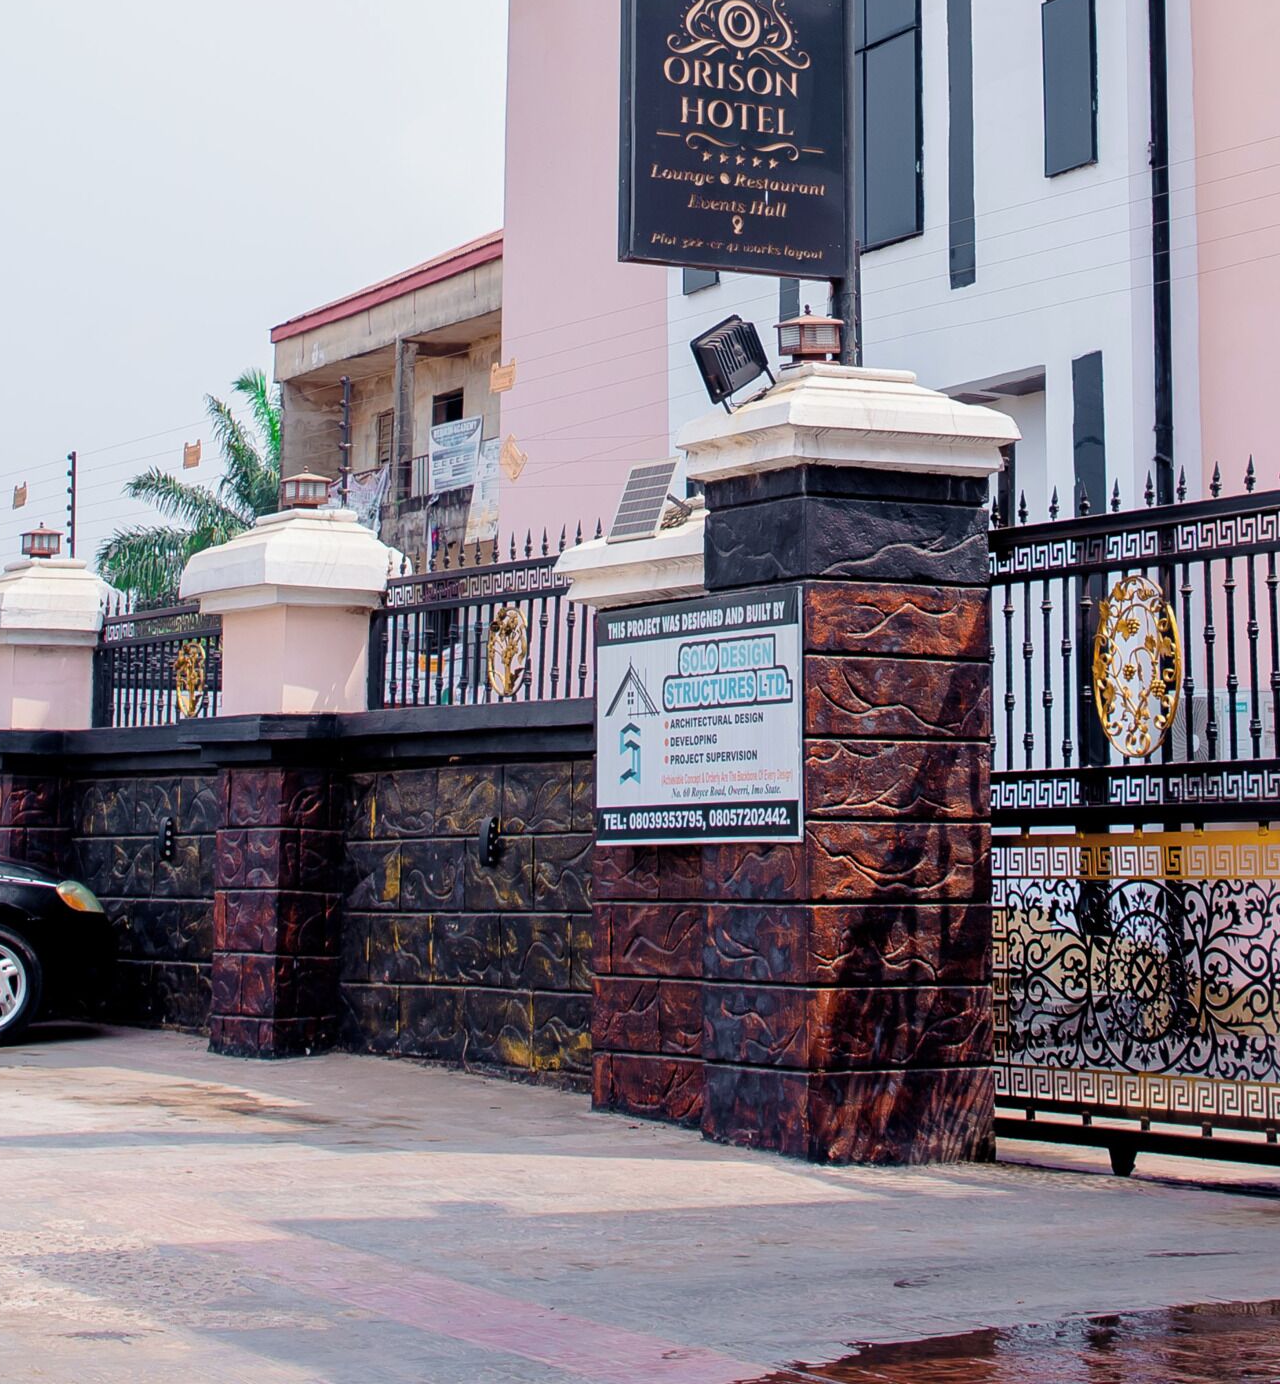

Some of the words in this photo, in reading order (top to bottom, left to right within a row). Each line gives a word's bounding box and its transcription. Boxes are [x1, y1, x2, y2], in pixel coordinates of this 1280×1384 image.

[663, 56, 799, 99] ORISON
[680, 96, 795, 136] HOTEL
[650, 163, 715, 186] Lounge
[733, 172, 826, 196] Restaurant
[687, 193, 747, 214] Events
[749, 200, 788, 217] Hall
[650, 232, 677, 245] Plot
[783, 245, 824, 261] layout
[607, 622, 626, 640] THIS
[627, 617, 661, 637] PROJECT
[661, 614, 680, 633] WAS
[681, 609, 723, 630] DESIGNED
[724, 606, 744, 626] AND
[745, 603, 771, 623] BUILT
[772, 601, 785, 620] BY
[681, 644, 717, 673] SOLO
[720, 641, 772, 668] DESIGN
[666, 675, 755, 705] STRUCTURES
[670, 714, 732, 729] ARCHITECTURAL
[734, 712, 764, 724] DESIGN
[670, 734, 718, 747] DEVELOPING
[670, 753, 704, 765] PROJECT
[706, 749, 758, 763] SUPERVISION
[751, 783, 764, 795] Imo
[765, 783, 782, 795] State.
[603, 813, 627, 830] TEL:
[629, 810, 706, 831] 08039353795,
[709, 806, 791, 827] 08057202442.
